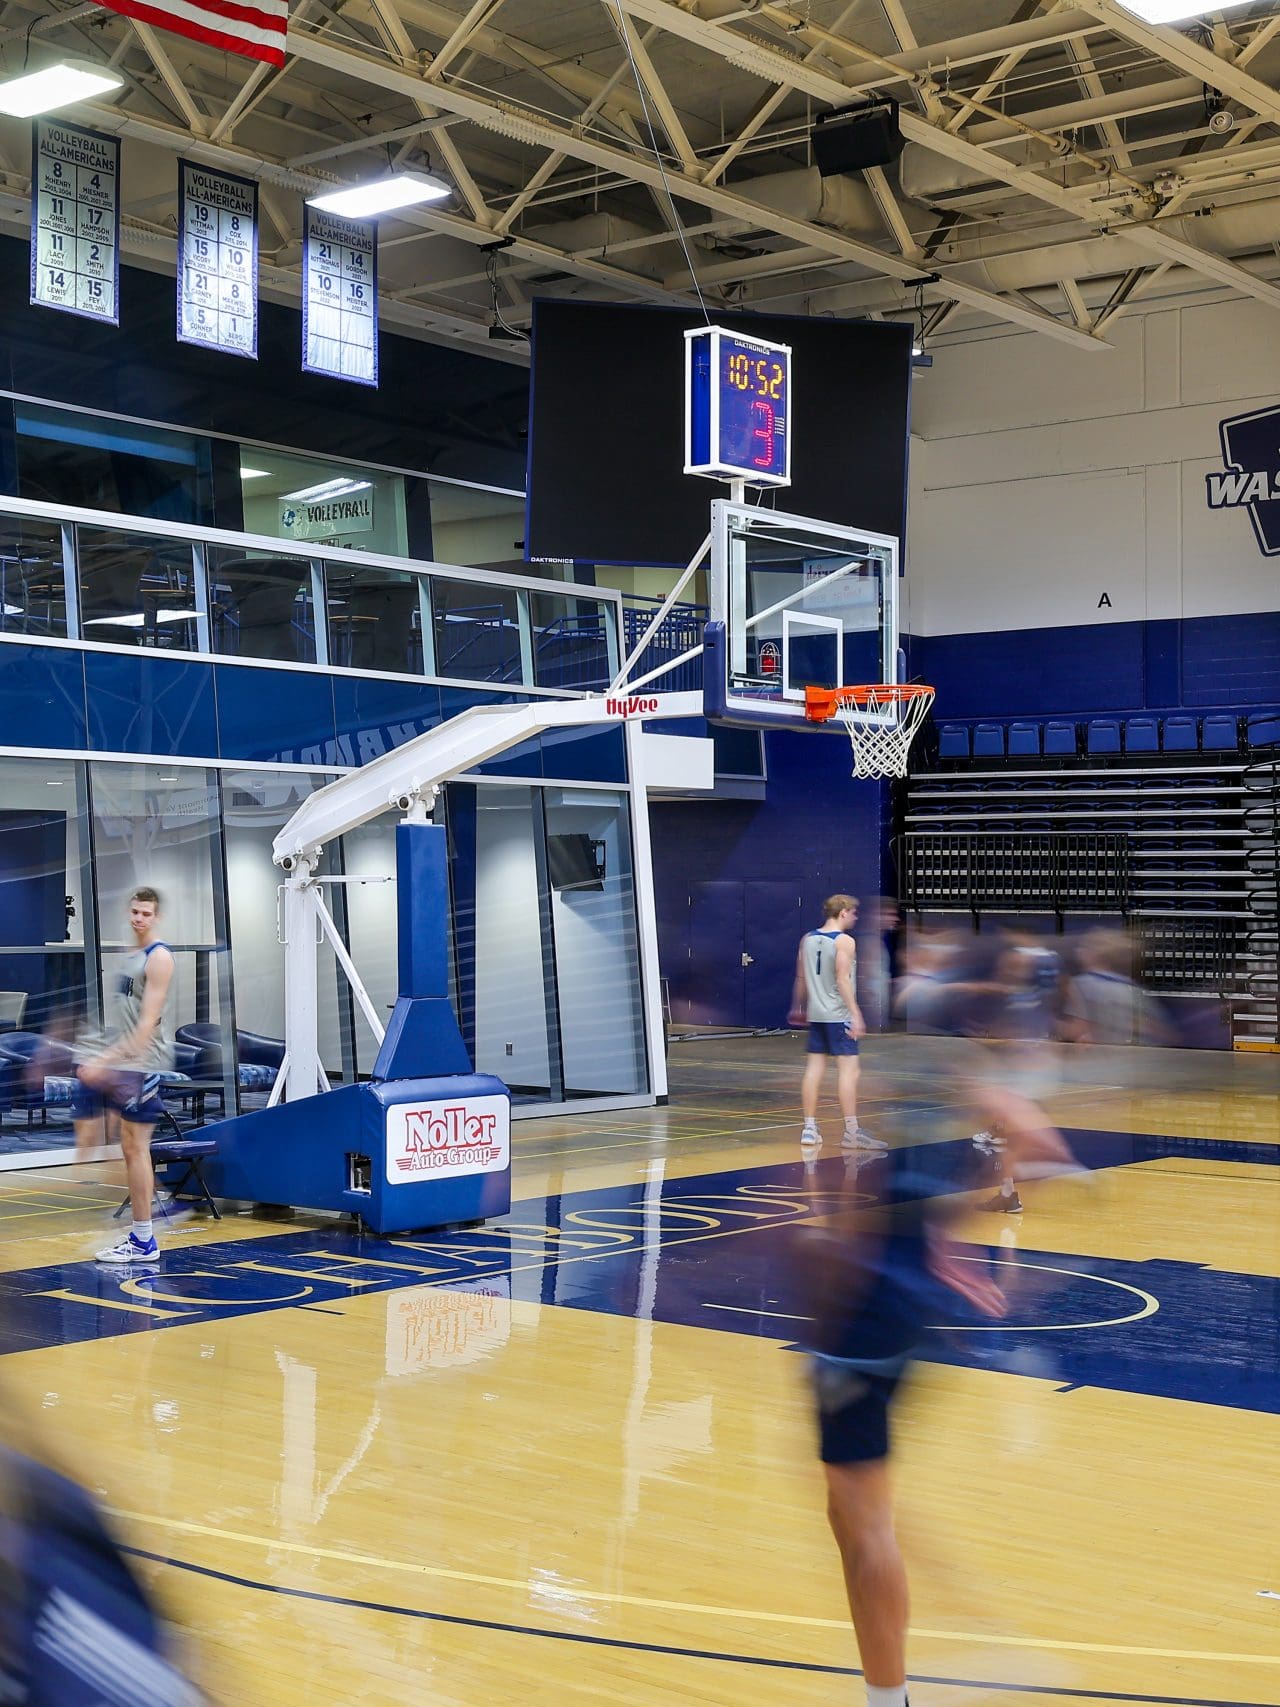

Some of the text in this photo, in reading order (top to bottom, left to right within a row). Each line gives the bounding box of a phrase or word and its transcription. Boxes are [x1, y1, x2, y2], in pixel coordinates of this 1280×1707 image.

[48, 128, 107, 155] VOLLEYBALL
[40, 139, 114, 171] ALL-AMERICANS
[53, 162, 62, 178] 8
[90, 174, 101, 189] 4
[192, 173, 246, 199] VOLLEYBALL
[51, 198, 63, 215] 11
[186, 185, 253, 214] ALL-AMERICANS
[49, 213, 67, 224] JONES
[88, 209, 103, 225] 17
[195, 205, 208, 221] 19
[231, 216, 240, 231] 8
[316, 212, 366, 237] VOLLEYBALL
[51, 234, 63, 251] 11
[229, 231, 242, 239] COX
[310, 224, 372, 250] ALL-AMERICANS
[49, 249, 65, 260] LACY
[90, 245, 99, 260] 2
[195, 239, 208, 256] 15
[319, 243, 331, 259] 21
[86, 260, 104, 270] SMITH
[228, 249, 243, 265] 10
[350, 252, 363, 267] 14
[49, 270, 65, 287] 14
[346, 265, 368, 276] GORDON
[88, 280, 102, 297] 15
[195, 274, 208, 290] 21
[318, 275, 331, 290] 10
[47, 286, 66, 296] LEWIS
[231, 284, 240, 299] 8
[350, 284, 363, 299] 16
[88, 296, 100, 304] FEY
[198, 310, 205, 324] 5
[232, 318, 237, 332] 1
[734, 339, 771, 356] DAKTRONICS
[729, 354, 782, 399] 10:52
[754, 401, 773, 466] 3
[307, 499, 370, 523] VOLLEYBALL
[1097, 592, 1112, 608] A
[816, 950, 822, 975] 1
[405, 1107, 496, 1152] Noller
[409, 1147, 492, 1171] Auto Group
[26, 1184, 880, 1321] ICHABODS
